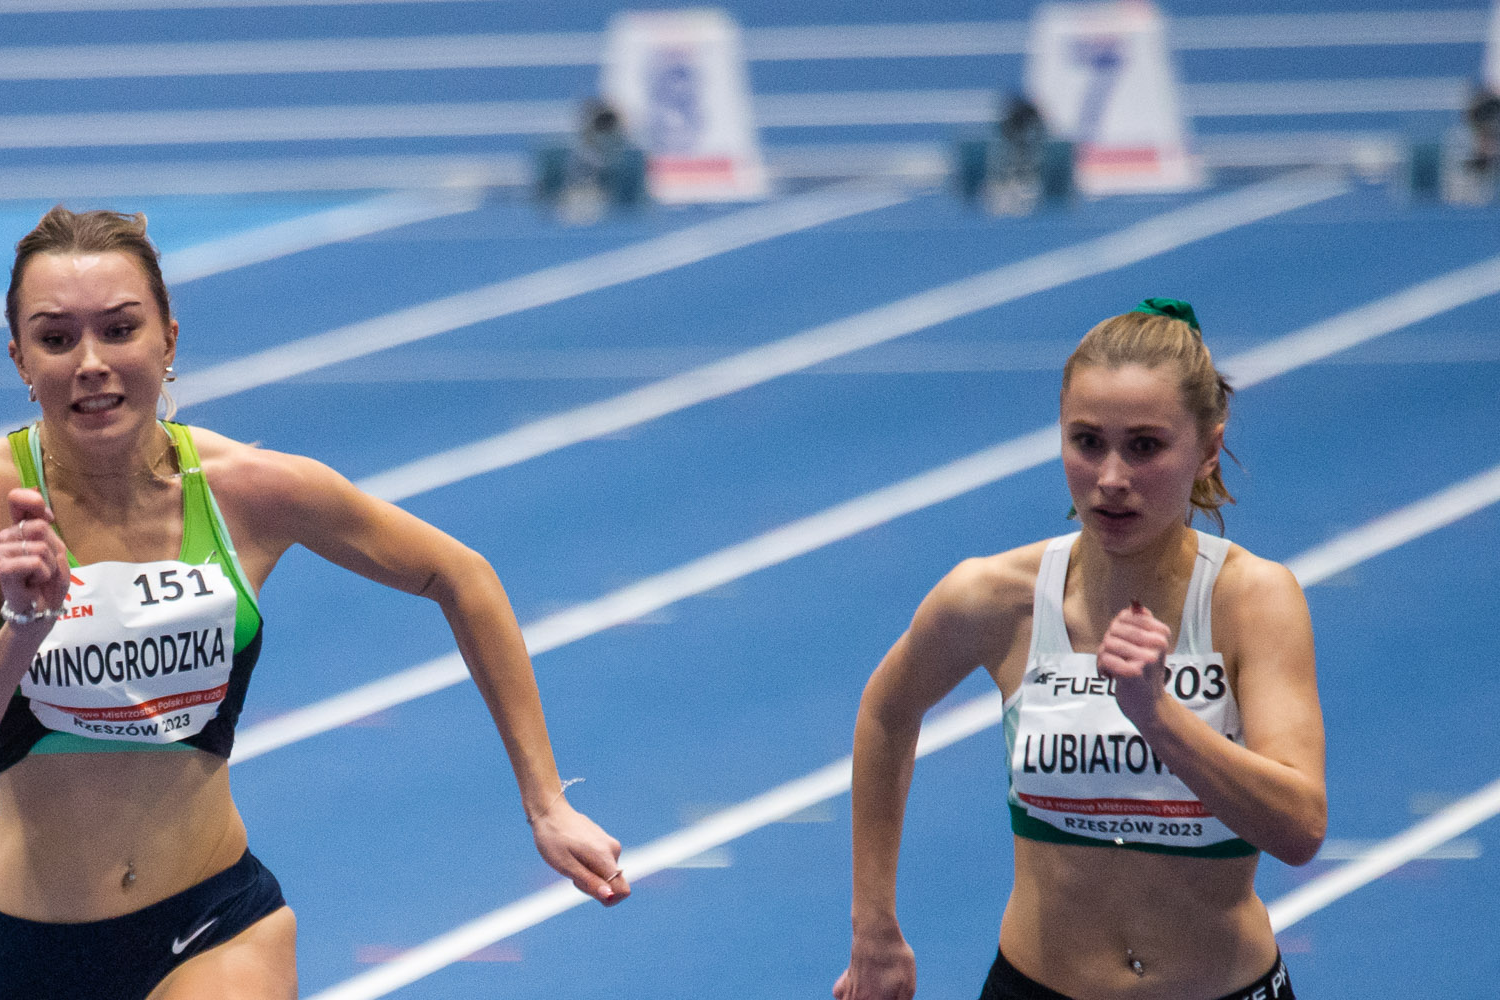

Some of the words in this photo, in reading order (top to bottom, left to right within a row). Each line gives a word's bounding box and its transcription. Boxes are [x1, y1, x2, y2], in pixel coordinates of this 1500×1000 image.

[1064, 33, 1130, 143] 7
[133, 568, 214, 606] 151
[57, 604, 93, 620] LEN
[28, 627, 226, 687] WINOGRODZKA
[158, 698, 184, 710] Polski
[1163, 804, 1194, 814] Polski
[1064, 817, 1154, 833] RZESZÓW
[1158, 822, 1203, 836] 2023
